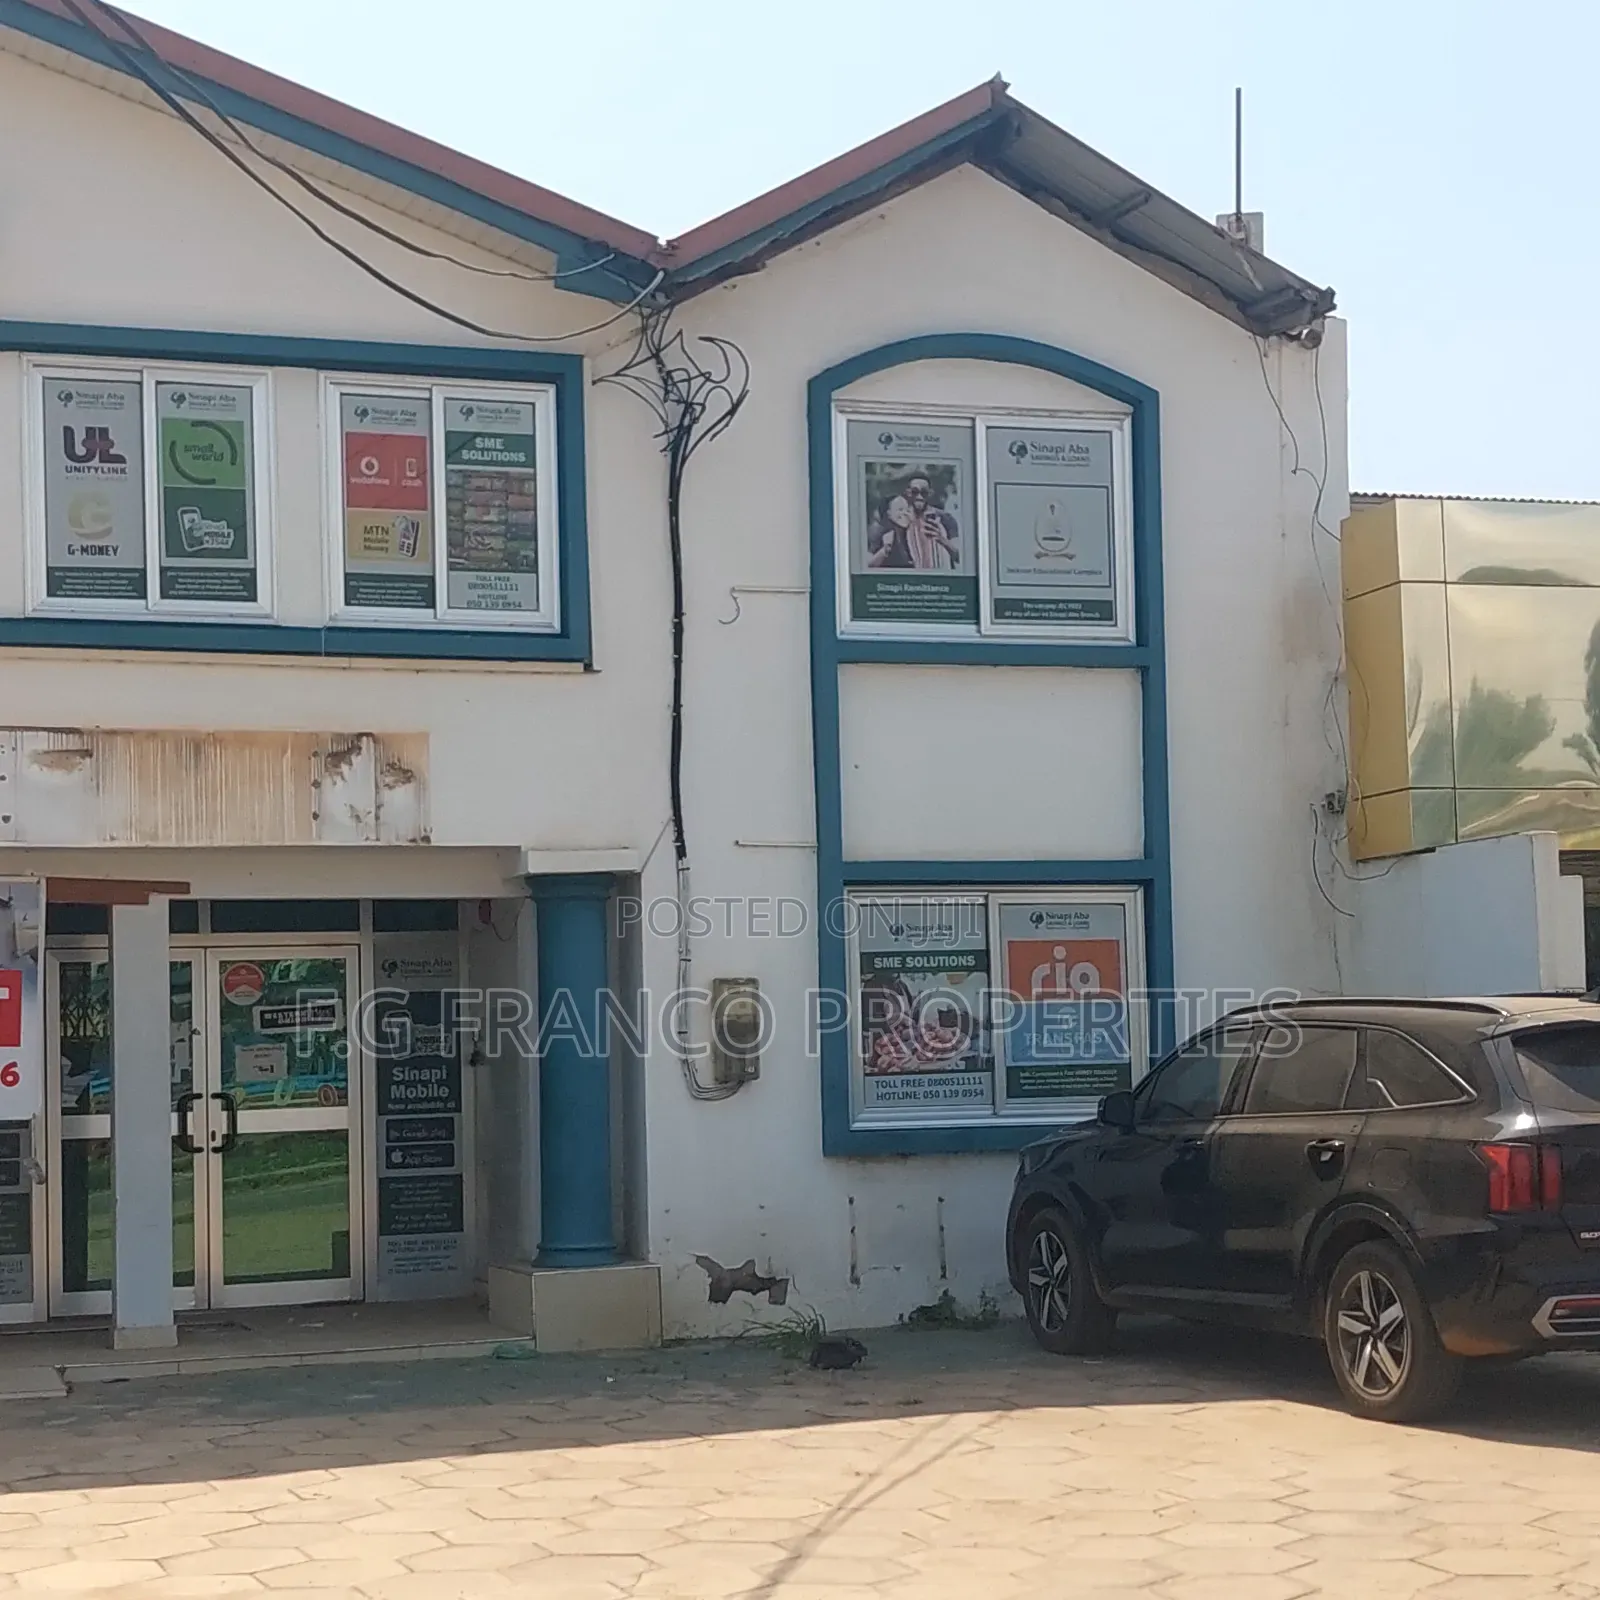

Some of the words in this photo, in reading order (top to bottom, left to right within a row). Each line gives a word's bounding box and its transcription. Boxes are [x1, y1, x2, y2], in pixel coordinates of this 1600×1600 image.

[184, 443, 214, 453] small
[475, 436, 505, 449] SME
[1030, 441, 1066, 456] Sinapi
[1068, 443, 1090, 454] Aba
[192, 451, 224, 462] world
[461, 449, 527, 462] SOLUTIONS
[65, 465, 128, 475] UNITYLINK
[364, 525, 389, 535] MTN
[67, 544, 119, 556] G-MONEY
[1046, 911, 1072, 921] Sinapi
[1073, 911, 1090, 920] Aba
[873, 956, 902, 969] SME
[905, 955, 976, 968] SOLUTIONS
[1031, 945, 1101, 994] ria
[1, 1061, 20, 1087] 6
[392, 1065, 448, 1083] Sinapi
[874, 1080, 898, 1089] TOLL
[928, 1076, 983, 1087] 0800511111
[390, 1083, 450, 1099] Mobile
[876, 1091, 921, 1101] HOTLINE:
[923, 1090, 940, 1099] 050
[944, 1089, 959, 1098] 139
[961, 1088, 984, 1098] 0954
